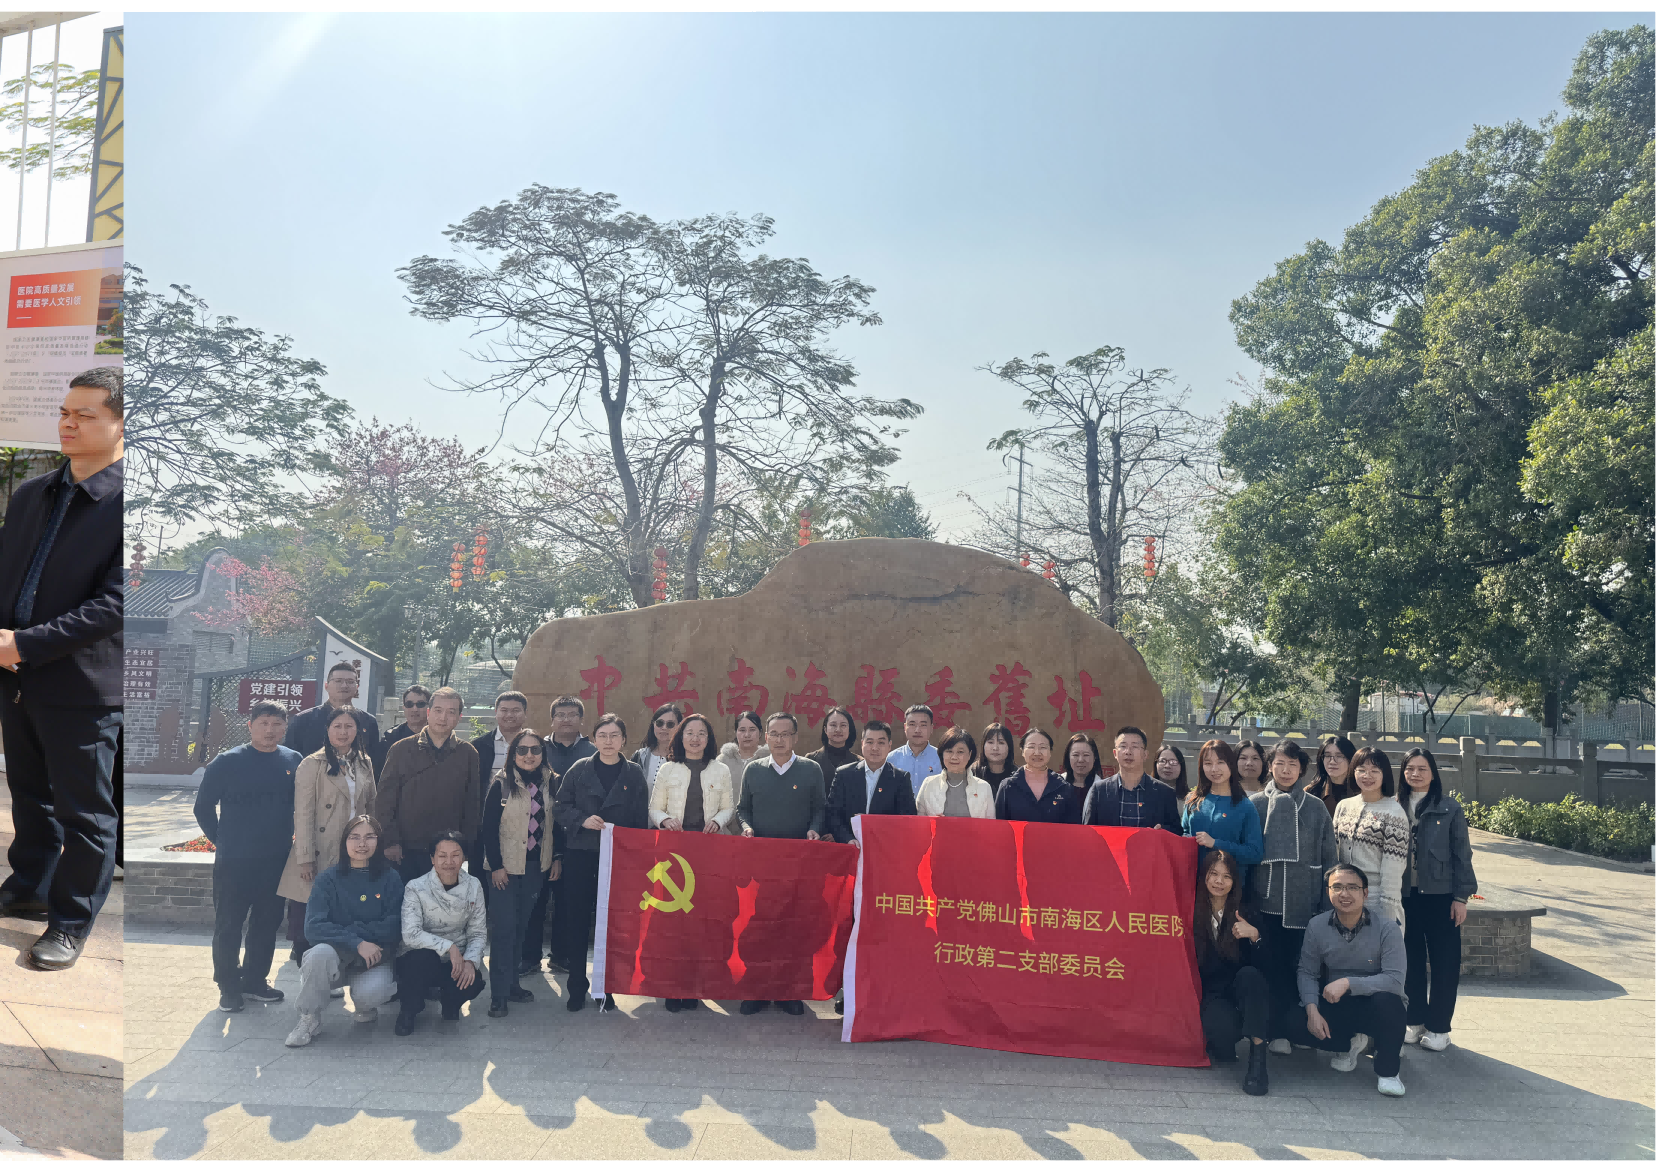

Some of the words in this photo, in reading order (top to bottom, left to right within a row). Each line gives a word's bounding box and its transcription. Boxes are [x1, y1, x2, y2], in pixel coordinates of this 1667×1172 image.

[17, 283, 75, 295] 医院高质量发展
[16, 295, 82, 308] 需要医学人文引领
[249, 683, 304, 696] 党建引领
[933, 941, 1126, 980] 行政第二支部委员会
